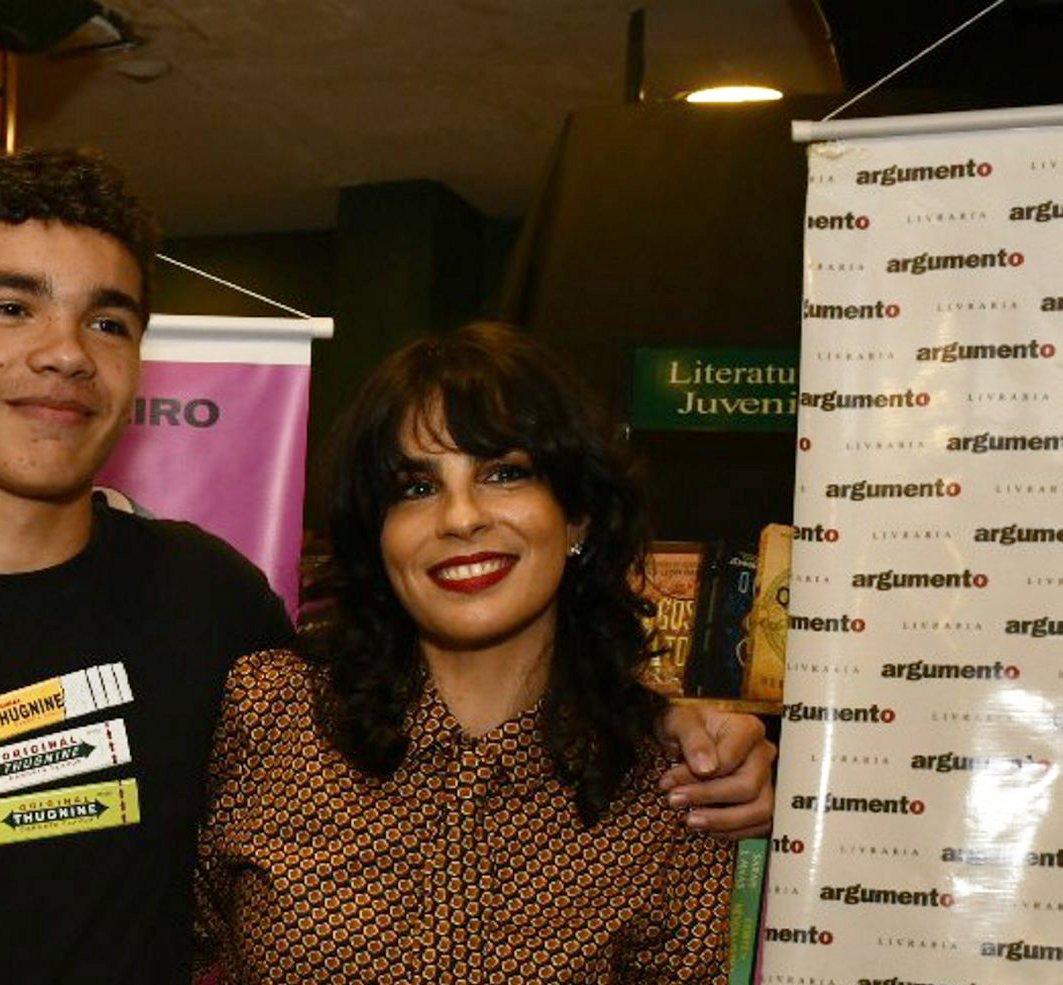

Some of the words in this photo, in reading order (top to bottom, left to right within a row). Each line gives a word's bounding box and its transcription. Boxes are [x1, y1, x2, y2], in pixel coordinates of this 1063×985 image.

[856, 159, 992, 186] argumento
[886, 249, 1024, 275] argumento
[916, 339, 1056, 363] argumento
[670, 361, 795, 385] Literatu
[128, 397, 220, 428] IRO
[800, 389, 930, 412] argumento
[826, 478, 961, 501] argumento
[852, 569, 988, 591] argumento
[881, 659, 1021, 681] argumento
[2, 736, 78, 760] ORIGINAL
[4, 747, 80, 776] THUGNINE
[13, 804, 98, 825] THUGNINE
[820, 884, 954, 907] argumento
